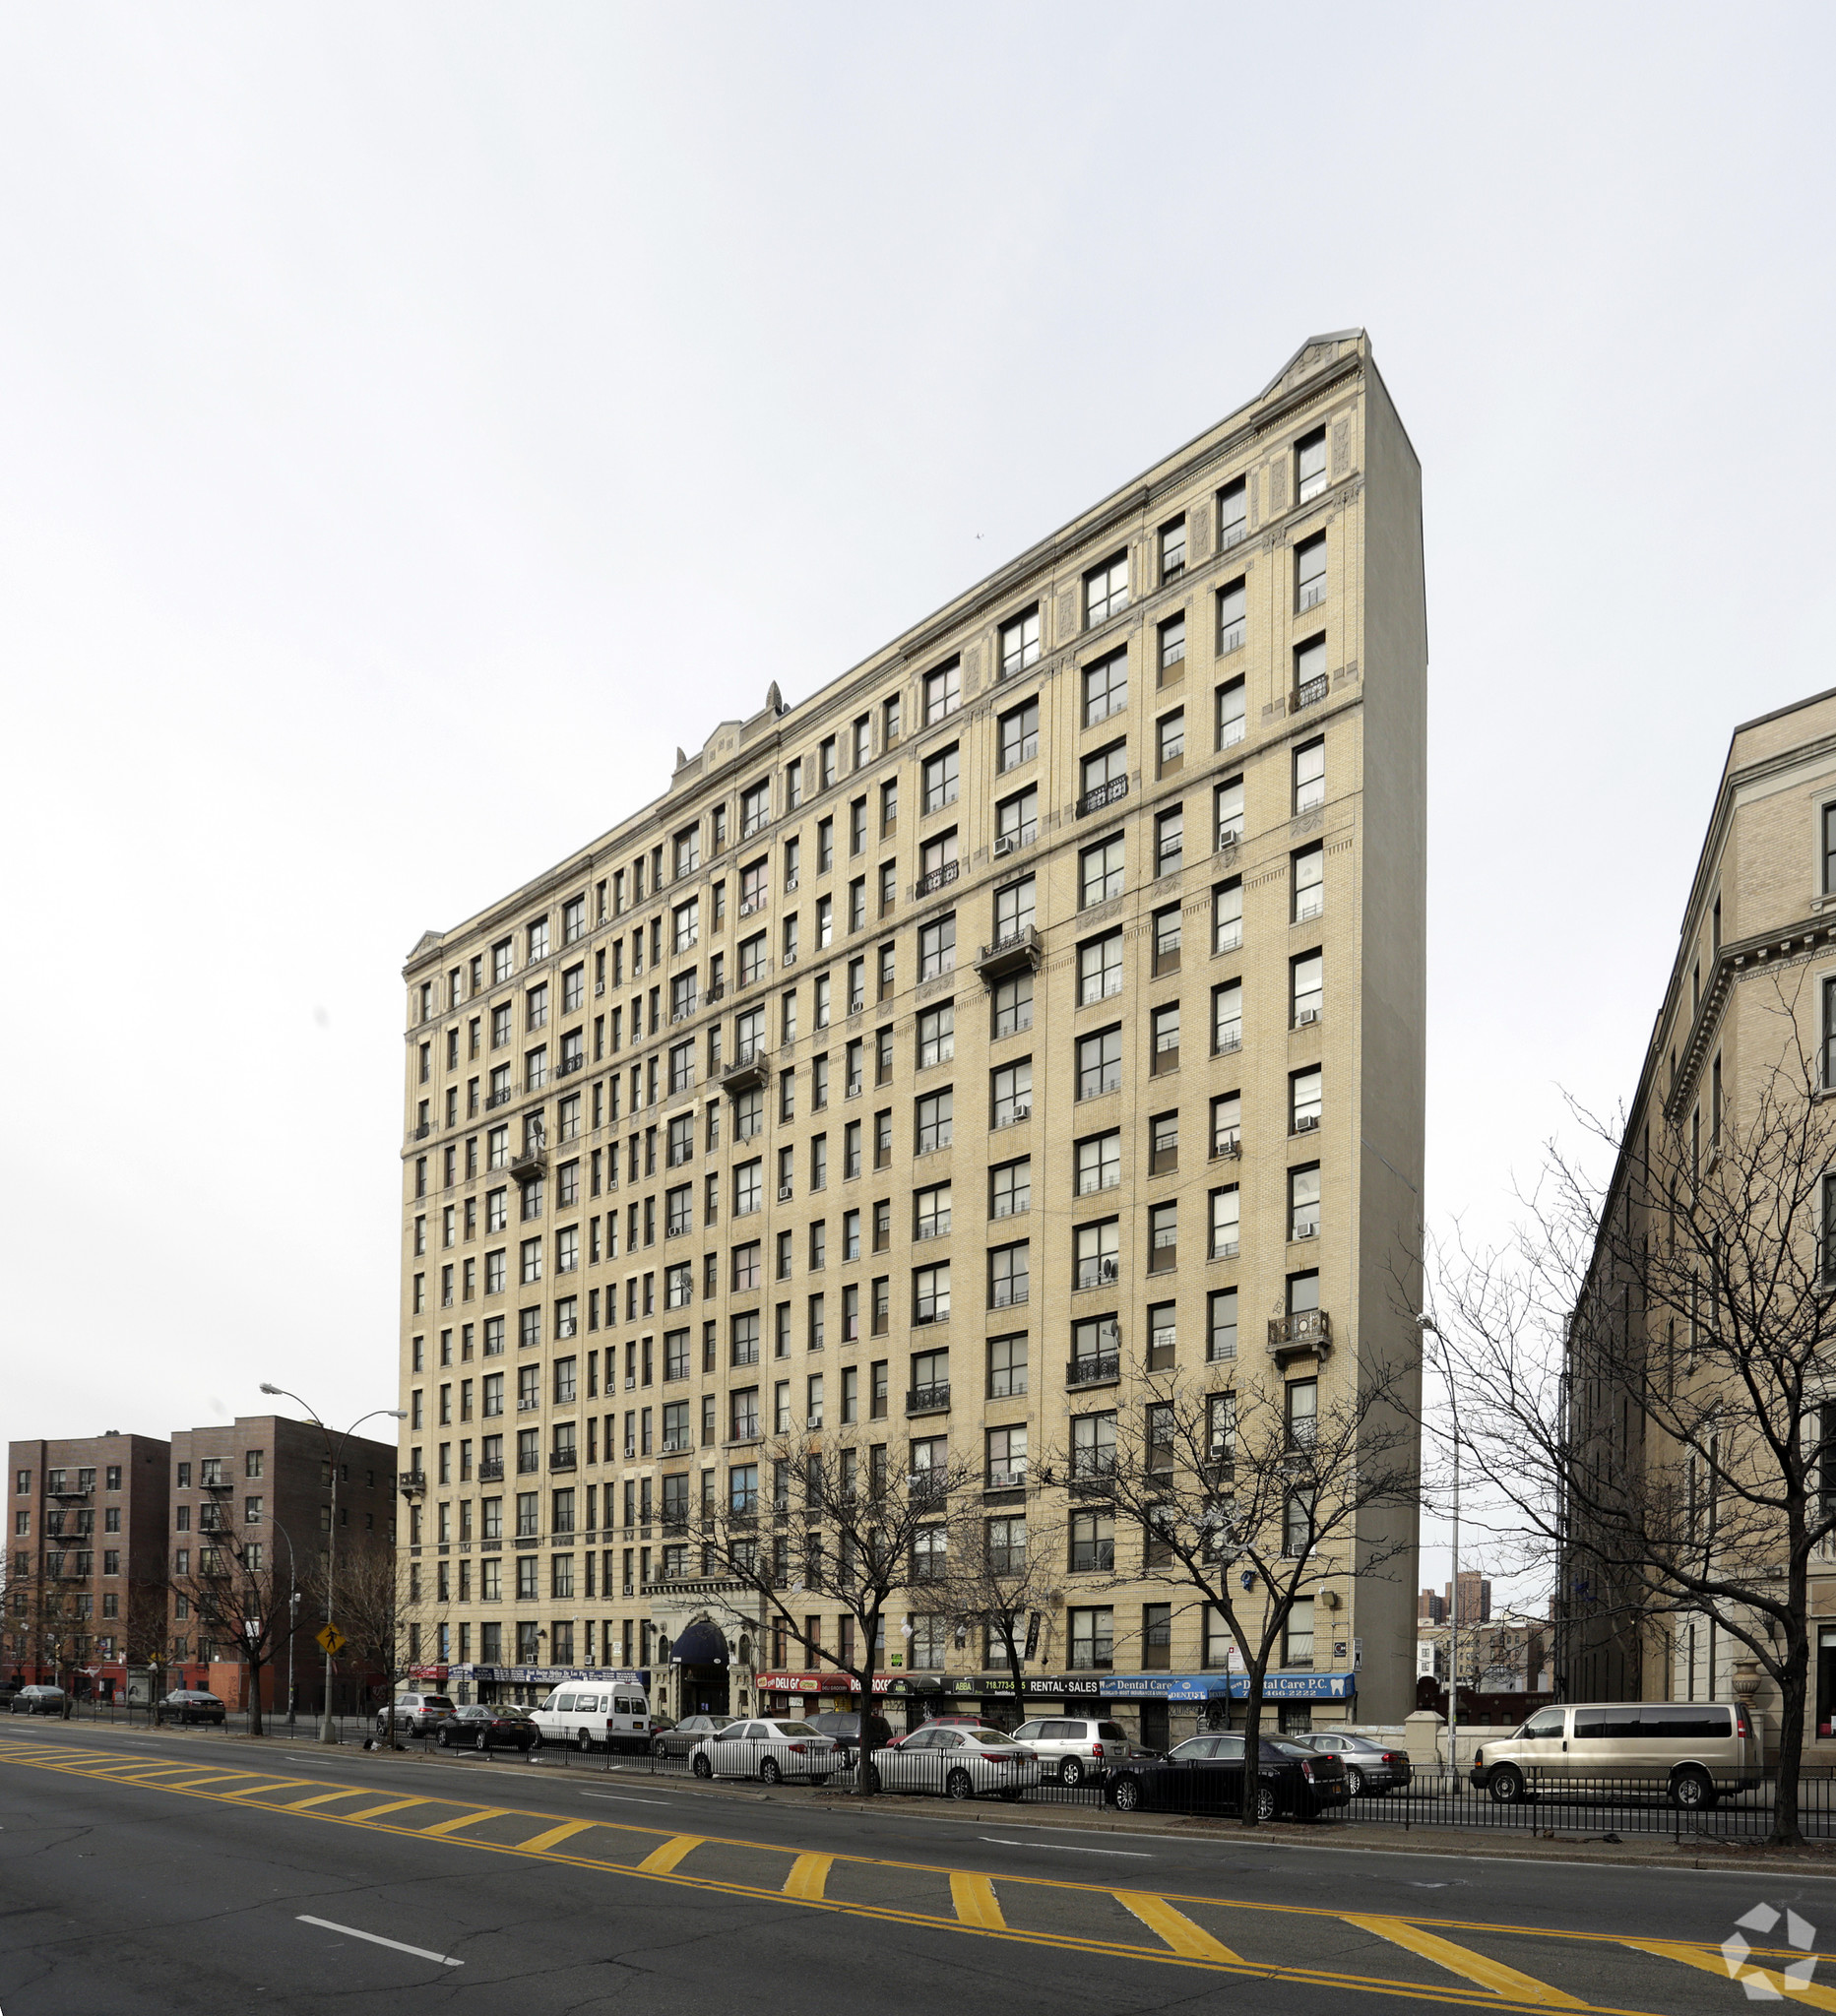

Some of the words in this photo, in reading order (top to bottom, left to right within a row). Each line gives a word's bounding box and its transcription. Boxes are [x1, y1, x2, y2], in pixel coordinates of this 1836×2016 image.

[775, 1676, 790, 1689] DELI
[955, 1681, 972, 1691] ABBA
[1030, 1680, 1064, 1692] RENTAL
[1068, 1680, 1098, 1692] SALES
[1117, 1679, 1148, 1690] Dental
[1150, 1679, 1172, 1690] Care
[1242, 1678, 1278, 1689] Dtal
[1280, 1678, 1305, 1689] Care
[1308, 1678, 1327, 1689] P.C.
